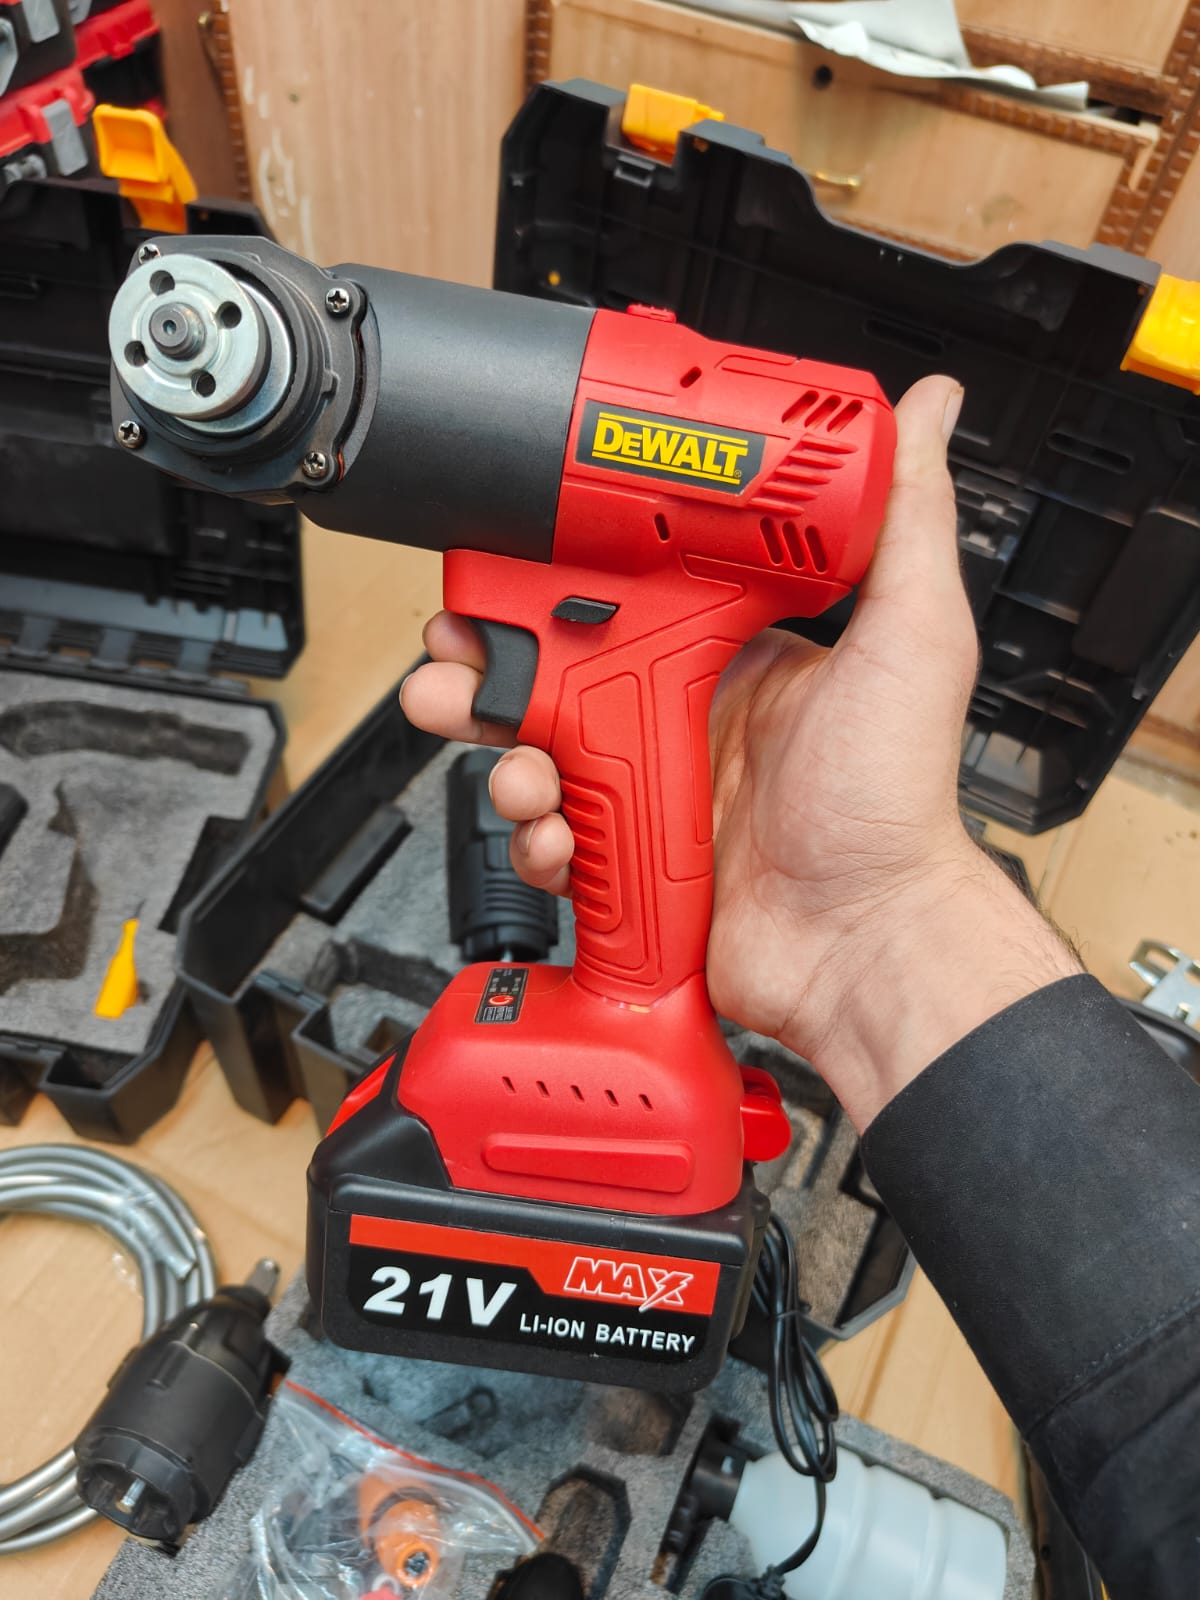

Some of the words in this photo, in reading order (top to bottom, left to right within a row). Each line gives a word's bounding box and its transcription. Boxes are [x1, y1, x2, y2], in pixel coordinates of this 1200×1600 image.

[593, 418, 748, 477] DEWALT
[363, 1266, 518, 1327] 21V
[563, 1256, 694, 1312] MAX
[519, 1313, 585, 1339] LI-ION
[595, 1323, 696, 1353] BATTERY
